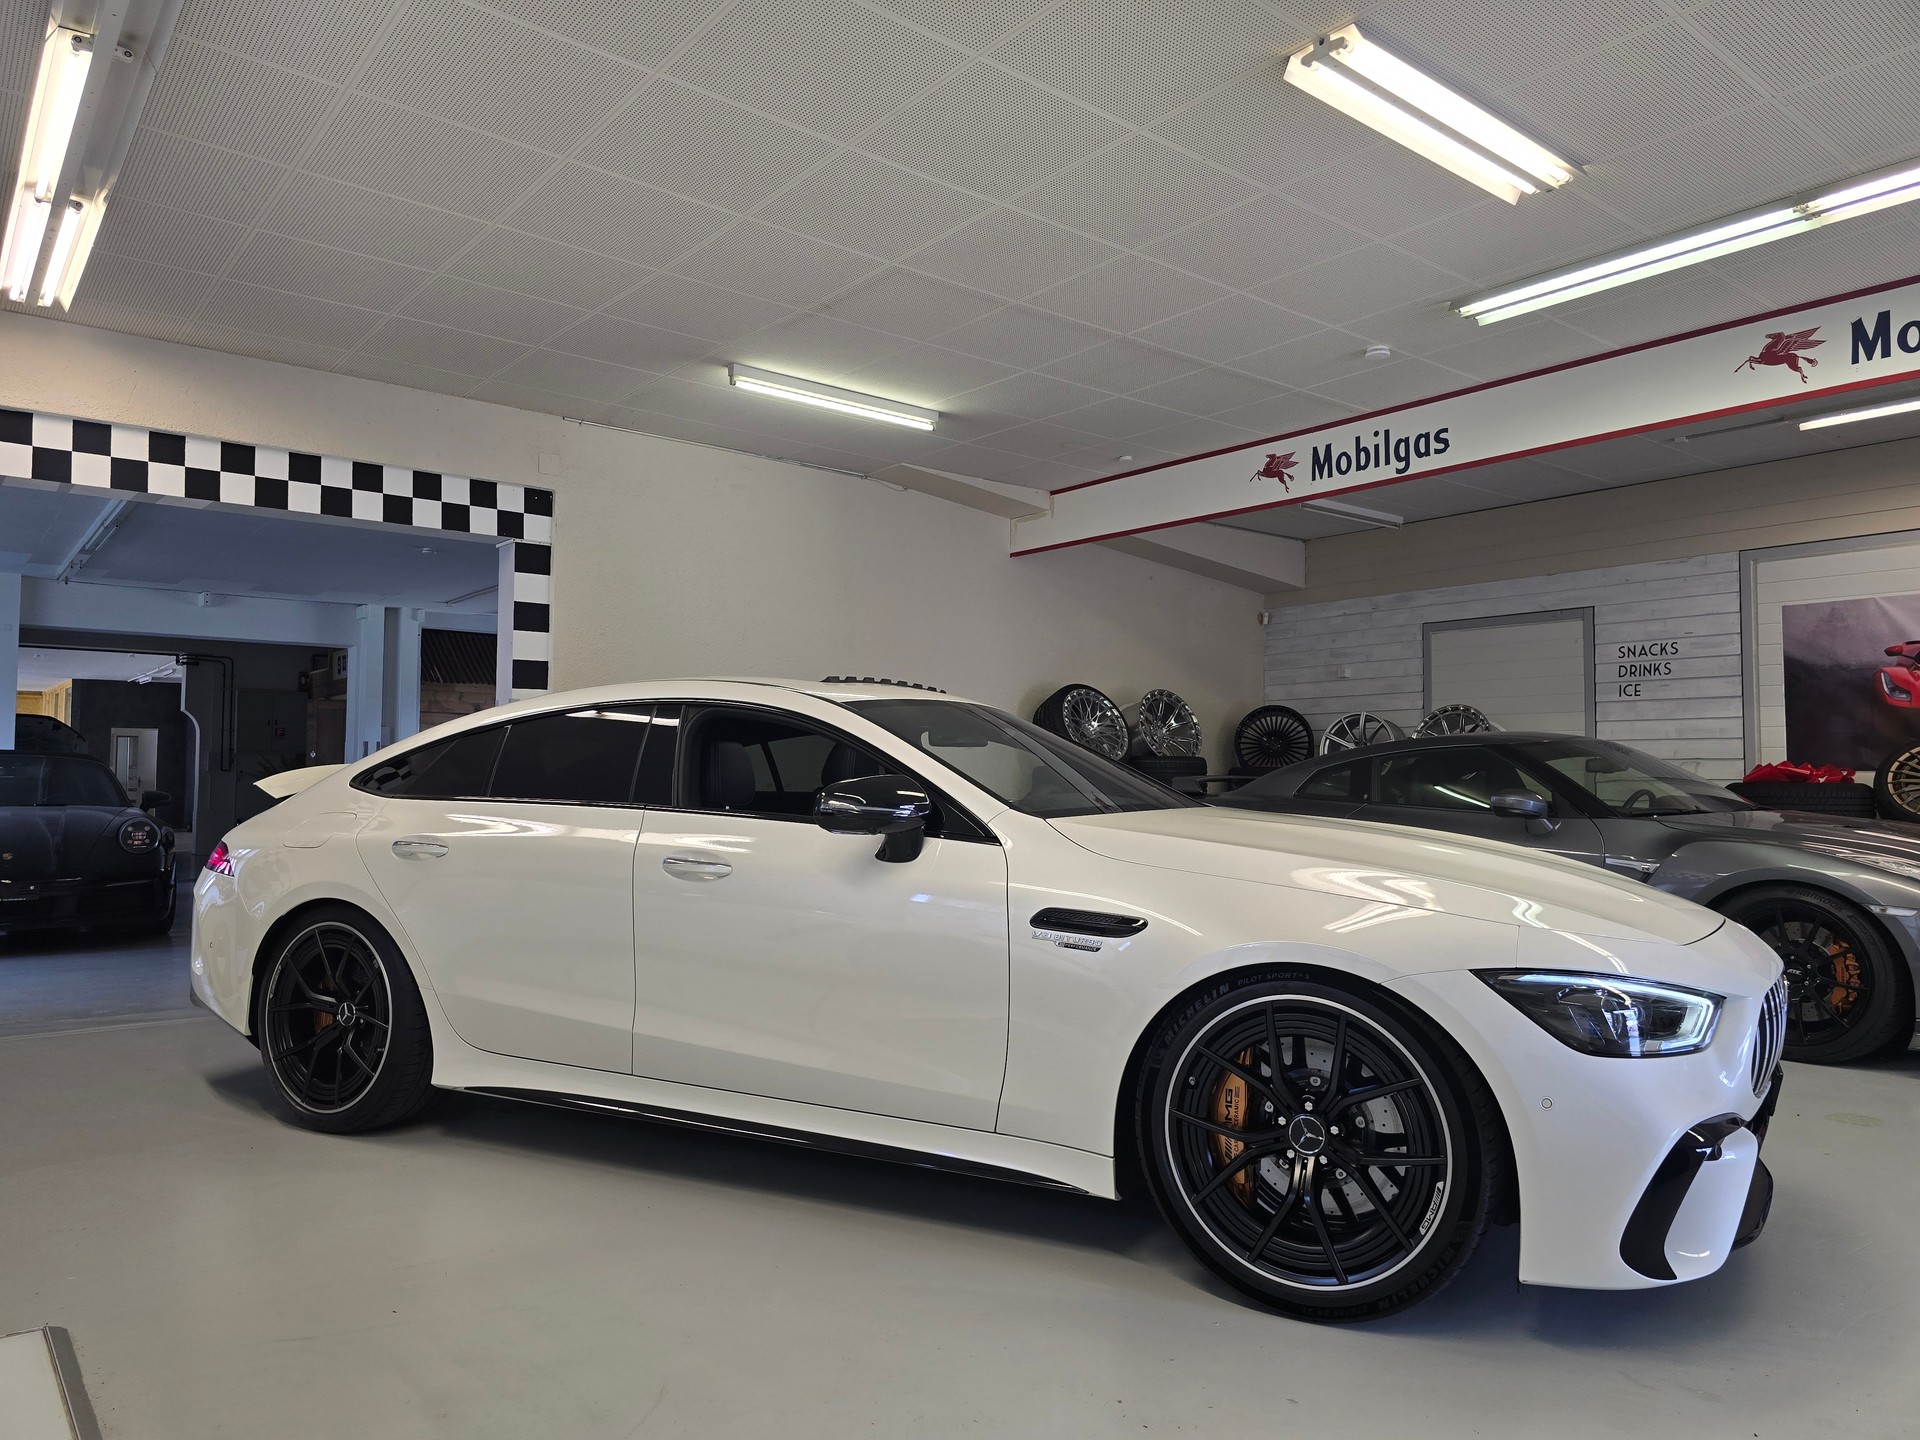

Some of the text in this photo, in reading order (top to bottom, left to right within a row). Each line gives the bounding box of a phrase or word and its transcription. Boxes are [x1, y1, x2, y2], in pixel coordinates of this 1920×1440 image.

[1851, 309, 1920, 365] Mo
[1311, 427, 1451, 483] Mobilgas
[1618, 641, 1679, 659] SNACKS
[1618, 662, 1672, 678] DRINKS
[1619, 683, 1641, 697] ICE
[1053, 934, 1104, 947] BITURBO
[1237, 974, 1263, 987] PILOT
[1163, 982, 1230, 1047] MICHELIN
[1224, 1088, 1233, 1125] MG
